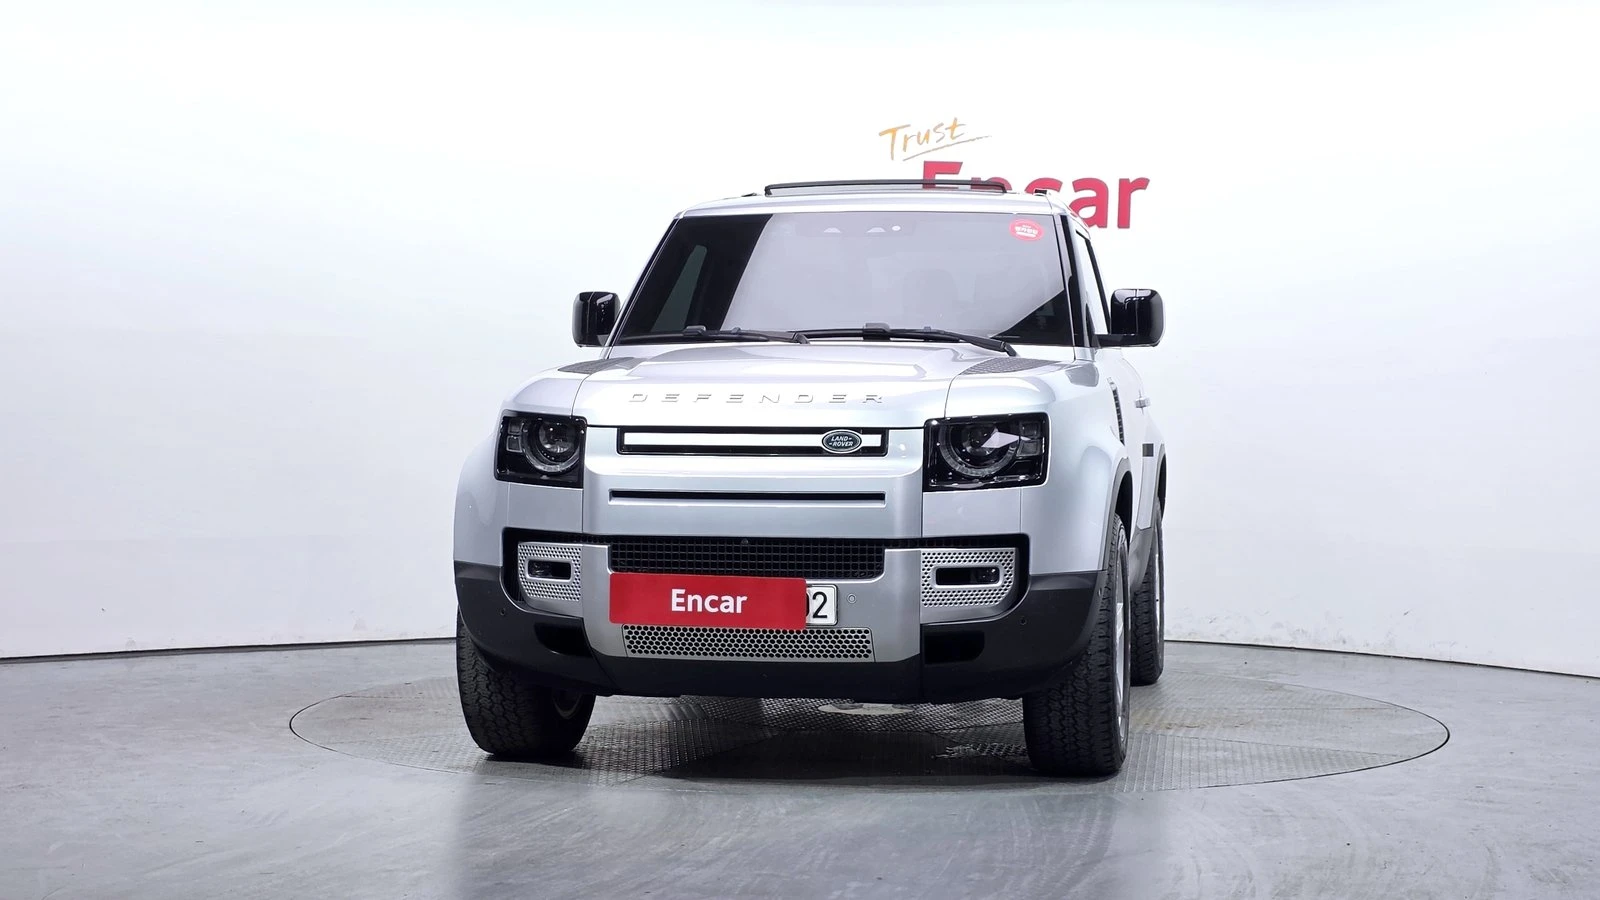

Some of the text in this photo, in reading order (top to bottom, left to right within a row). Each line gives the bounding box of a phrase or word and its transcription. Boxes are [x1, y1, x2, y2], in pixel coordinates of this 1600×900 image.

[879, 117, 967, 161] Trust
[629, 393, 883, 404] DEFENDER
[671, 588, 748, 614] Encar
[806, 590, 828, 620] 2
